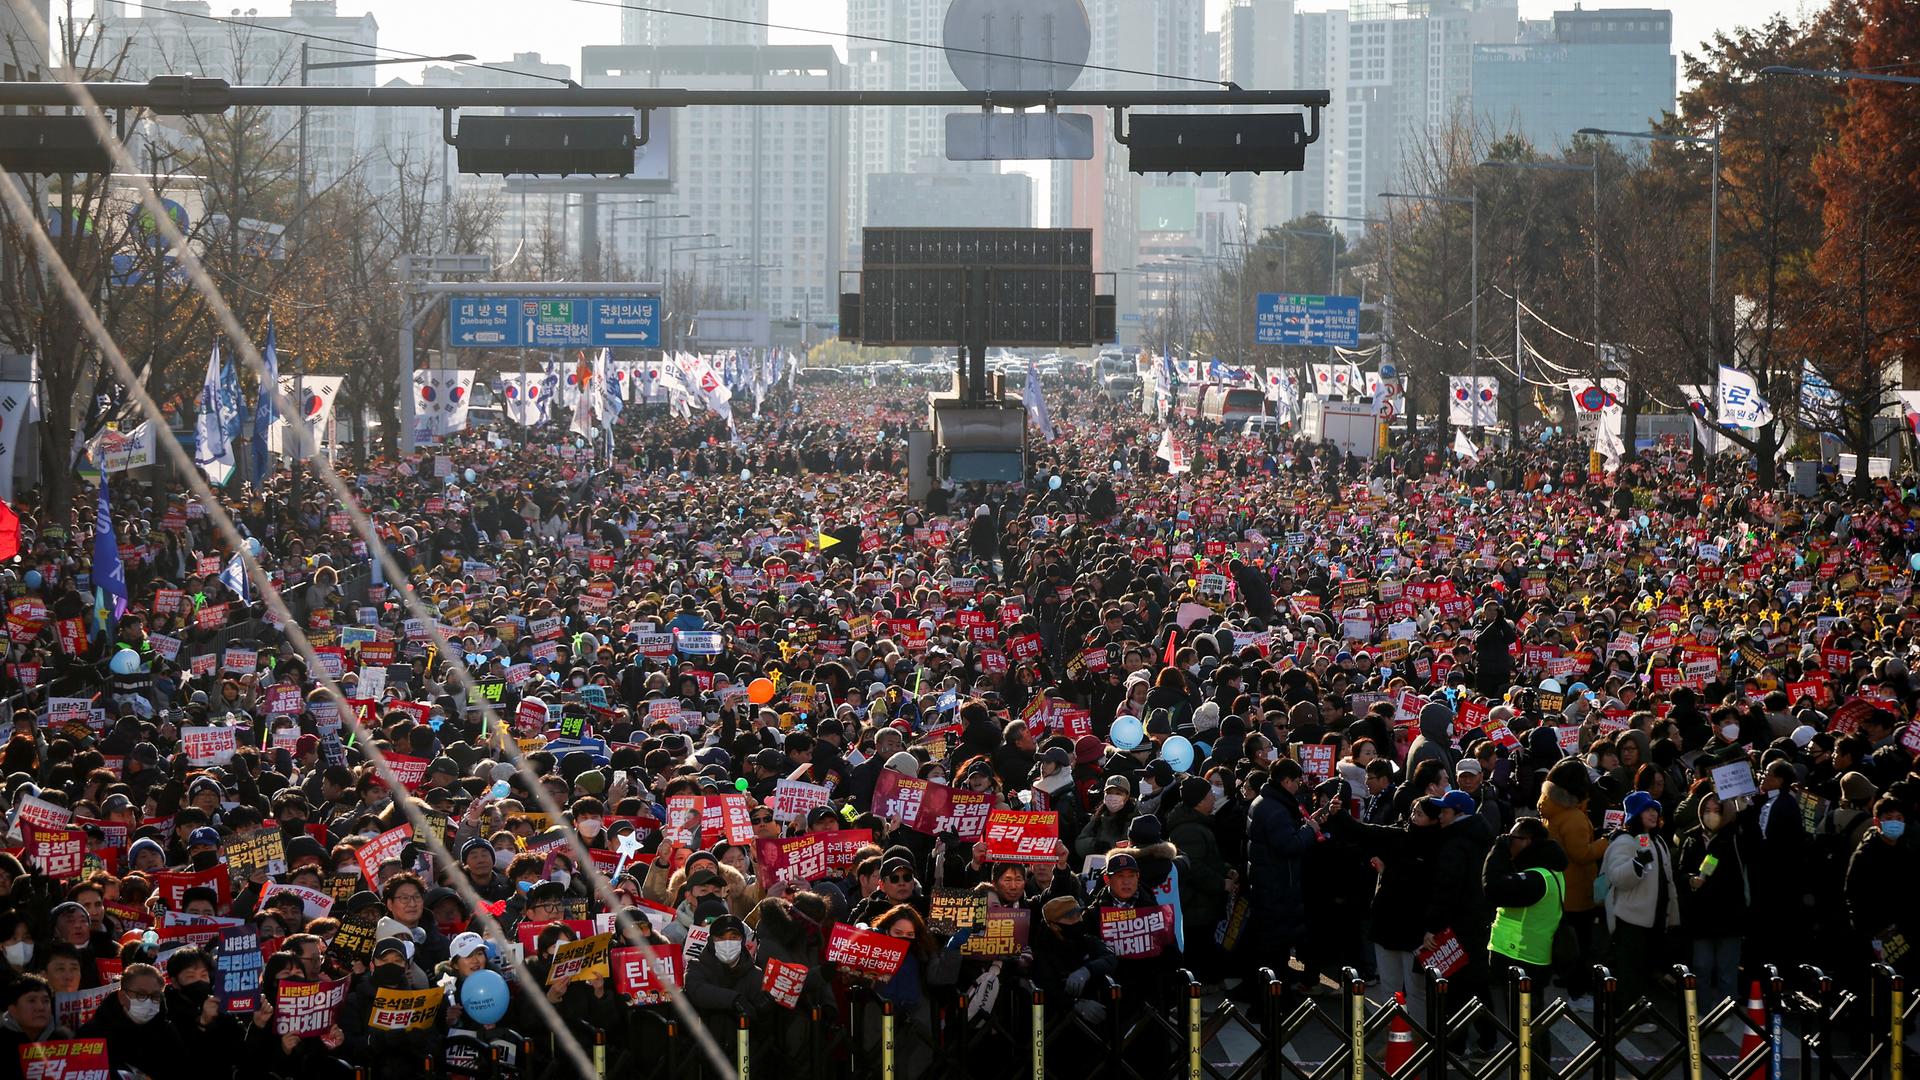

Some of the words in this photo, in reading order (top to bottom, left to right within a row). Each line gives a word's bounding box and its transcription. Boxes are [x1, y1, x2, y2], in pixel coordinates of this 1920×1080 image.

[461, 304, 508, 317] 대방역
[541, 303, 569, 316] 인천
[600, 304, 653, 318] 국회의사당
[460, 317, 493, 326] Daebang
[494, 317, 507, 325] Stn
[617, 317, 651, 327] Assembly
[1259, 313, 1282, 322] 대방역
[536, 324, 589, 337] 영등포경찰서
[1207, 543, 1223, 552] 탄핵
[593, 559, 611, 568] 탄핵
[1756, 551, 1772, 562] 탄핵
[768, 567, 785, 577] 탄핵
[1702, 571, 1720, 580] 탄핵
[1406, 585, 1424, 597] 탄핵
[1394, 602, 1413, 614] 탄핵
[1443, 602, 1463, 613] 탄핵
[531, 620, 558, 632] 내란수괴
[959, 614, 980, 626] 탄핵
[737, 628, 757, 638] 탄핵
[973, 626, 995, 639] 탄핵
[640, 636, 671, 645] 내란수괴
[1016, 640, 1038, 656] 탄핵
[986, 654, 1006, 666] 탄핵
[1529, 650, 1553, 662] 탄핵
[1828, 654, 1847, 666] 탄핵
[1791, 685, 1817, 700] 탄핵
[52, 702, 88, 713] 내란수괴
[271, 697, 302, 713] 체포!
[561, 717, 584, 737] 탄핵
[184, 732, 209, 744] 내란범
[210, 729, 232, 742] 윤석열
[184, 739, 234, 761] 체포하라
[780, 786, 805, 797] 내란범
[806, 788, 828, 801] 윤석열
[898, 788, 923, 802] 윤석
[952, 793, 985, 804] 반란수괴
[22, 804, 49, 820] 내란범
[952, 802, 991, 817] 윤석열
[932, 814, 987, 837] 체포!
[988, 811, 1028, 825] 내란수괴
[1028, 813, 1057, 825] 윤석열
[34, 831, 69, 842] 반란수괴
[226, 839, 256, 856] 내란수괴
[261, 831, 281, 845] 윤석열
[987, 823, 1026, 843] 즉각
[1016, 836, 1058, 855] 탄핵!
[37, 839, 81, 857] 윤석열
[782, 836, 815, 854] 반란수괴
[788, 840, 825, 864] 윤석열
[827, 841, 843, 852] 수괴
[228, 850, 254, 870] 즉각
[252, 841, 286, 870] 탄핵
[775, 857, 826, 884] 체포!
[303, 888, 332, 909] 윤석열
[932, 896, 964, 907] 내란수괴
[931, 906, 957, 922] 즉각
[956, 905, 987, 928] 탄핵
[1101, 908, 1137, 923] 내란공범
[1102, 911, 1166, 940] 국민의힘
[224, 933, 258, 953] 내란공범
[334, 932, 361, 951] 즉각
[831, 936, 870, 956] 내란수괴
[871, 946, 902, 962] 윤석열
[553, 941, 597, 965] 윤석열을
[218, 951, 263, 972] 국민의힘
[553, 952, 609, 979] 탄핵하라
[828, 949, 858, 965] 법대로
[857, 956, 898, 973] 처단하라
[625, 955, 676, 988] 탄핵
[279, 983, 321, 997] 내란공범
[232, 998, 252, 1008] 진보당
[278, 983, 346, 1016] 국민의힘
[373, 995, 427, 1012] 윤석열을
[276, 1010, 330, 1036] 해체!
[1689, 1015, 1700, 1071] POLICE
[22, 1046, 70, 1060] 내란수괴
[70, 1042, 104, 1056] 윤석열
[26, 1058, 67, 1080] 즉각
